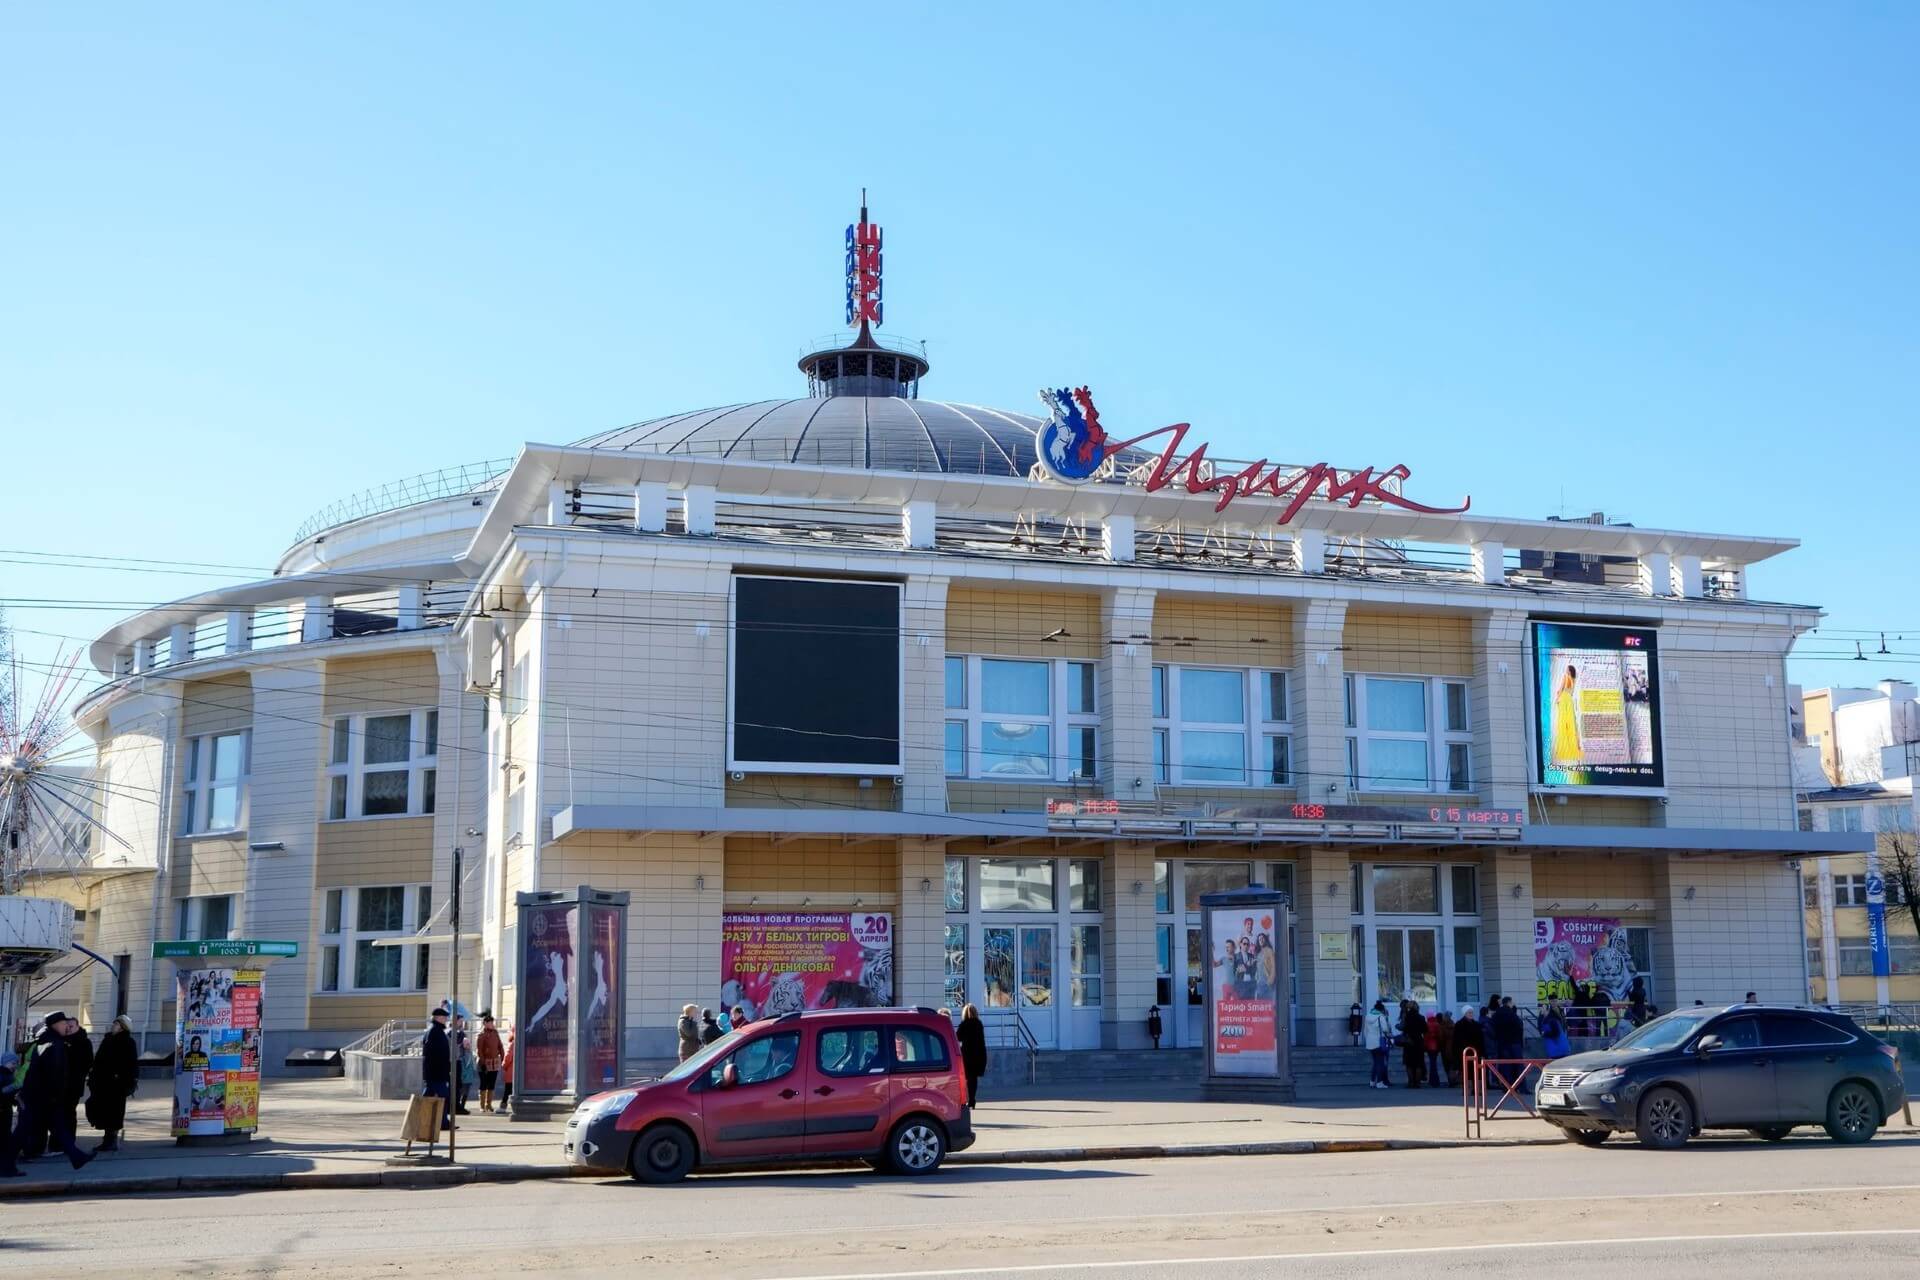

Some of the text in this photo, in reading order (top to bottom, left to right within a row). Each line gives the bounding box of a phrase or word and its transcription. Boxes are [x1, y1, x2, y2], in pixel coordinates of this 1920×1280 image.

[857, 223, 879, 322] ЦИРК
[1104, 422, 1470, 525] Цирк
[1291, 804, 1325, 818] 11:36
[1447, 808, 1460, 822] 15
[1467, 810, 1509, 823] марта
[864, 916, 888, 934] 20
[1563, 922, 1604, 932] СОБЫТИЕ
[757, 932, 763, 942] 7
[766, 932, 803, 942] БЕЛЫХ
[807, 932, 850, 942] ТИГРОВ!
[1869, 912, 1878, 952] ZURICH
[859, 935, 889, 943] АПРЕЛЯ
[1571, 935, 1596, 944] ГОДА!
[734, 962, 834, 973] ОЛЬГА ДЕНИСОВА!
[217, 1008, 231, 1017] ХОР
[1219, 1002, 1272, 1012] Тариф Smart
